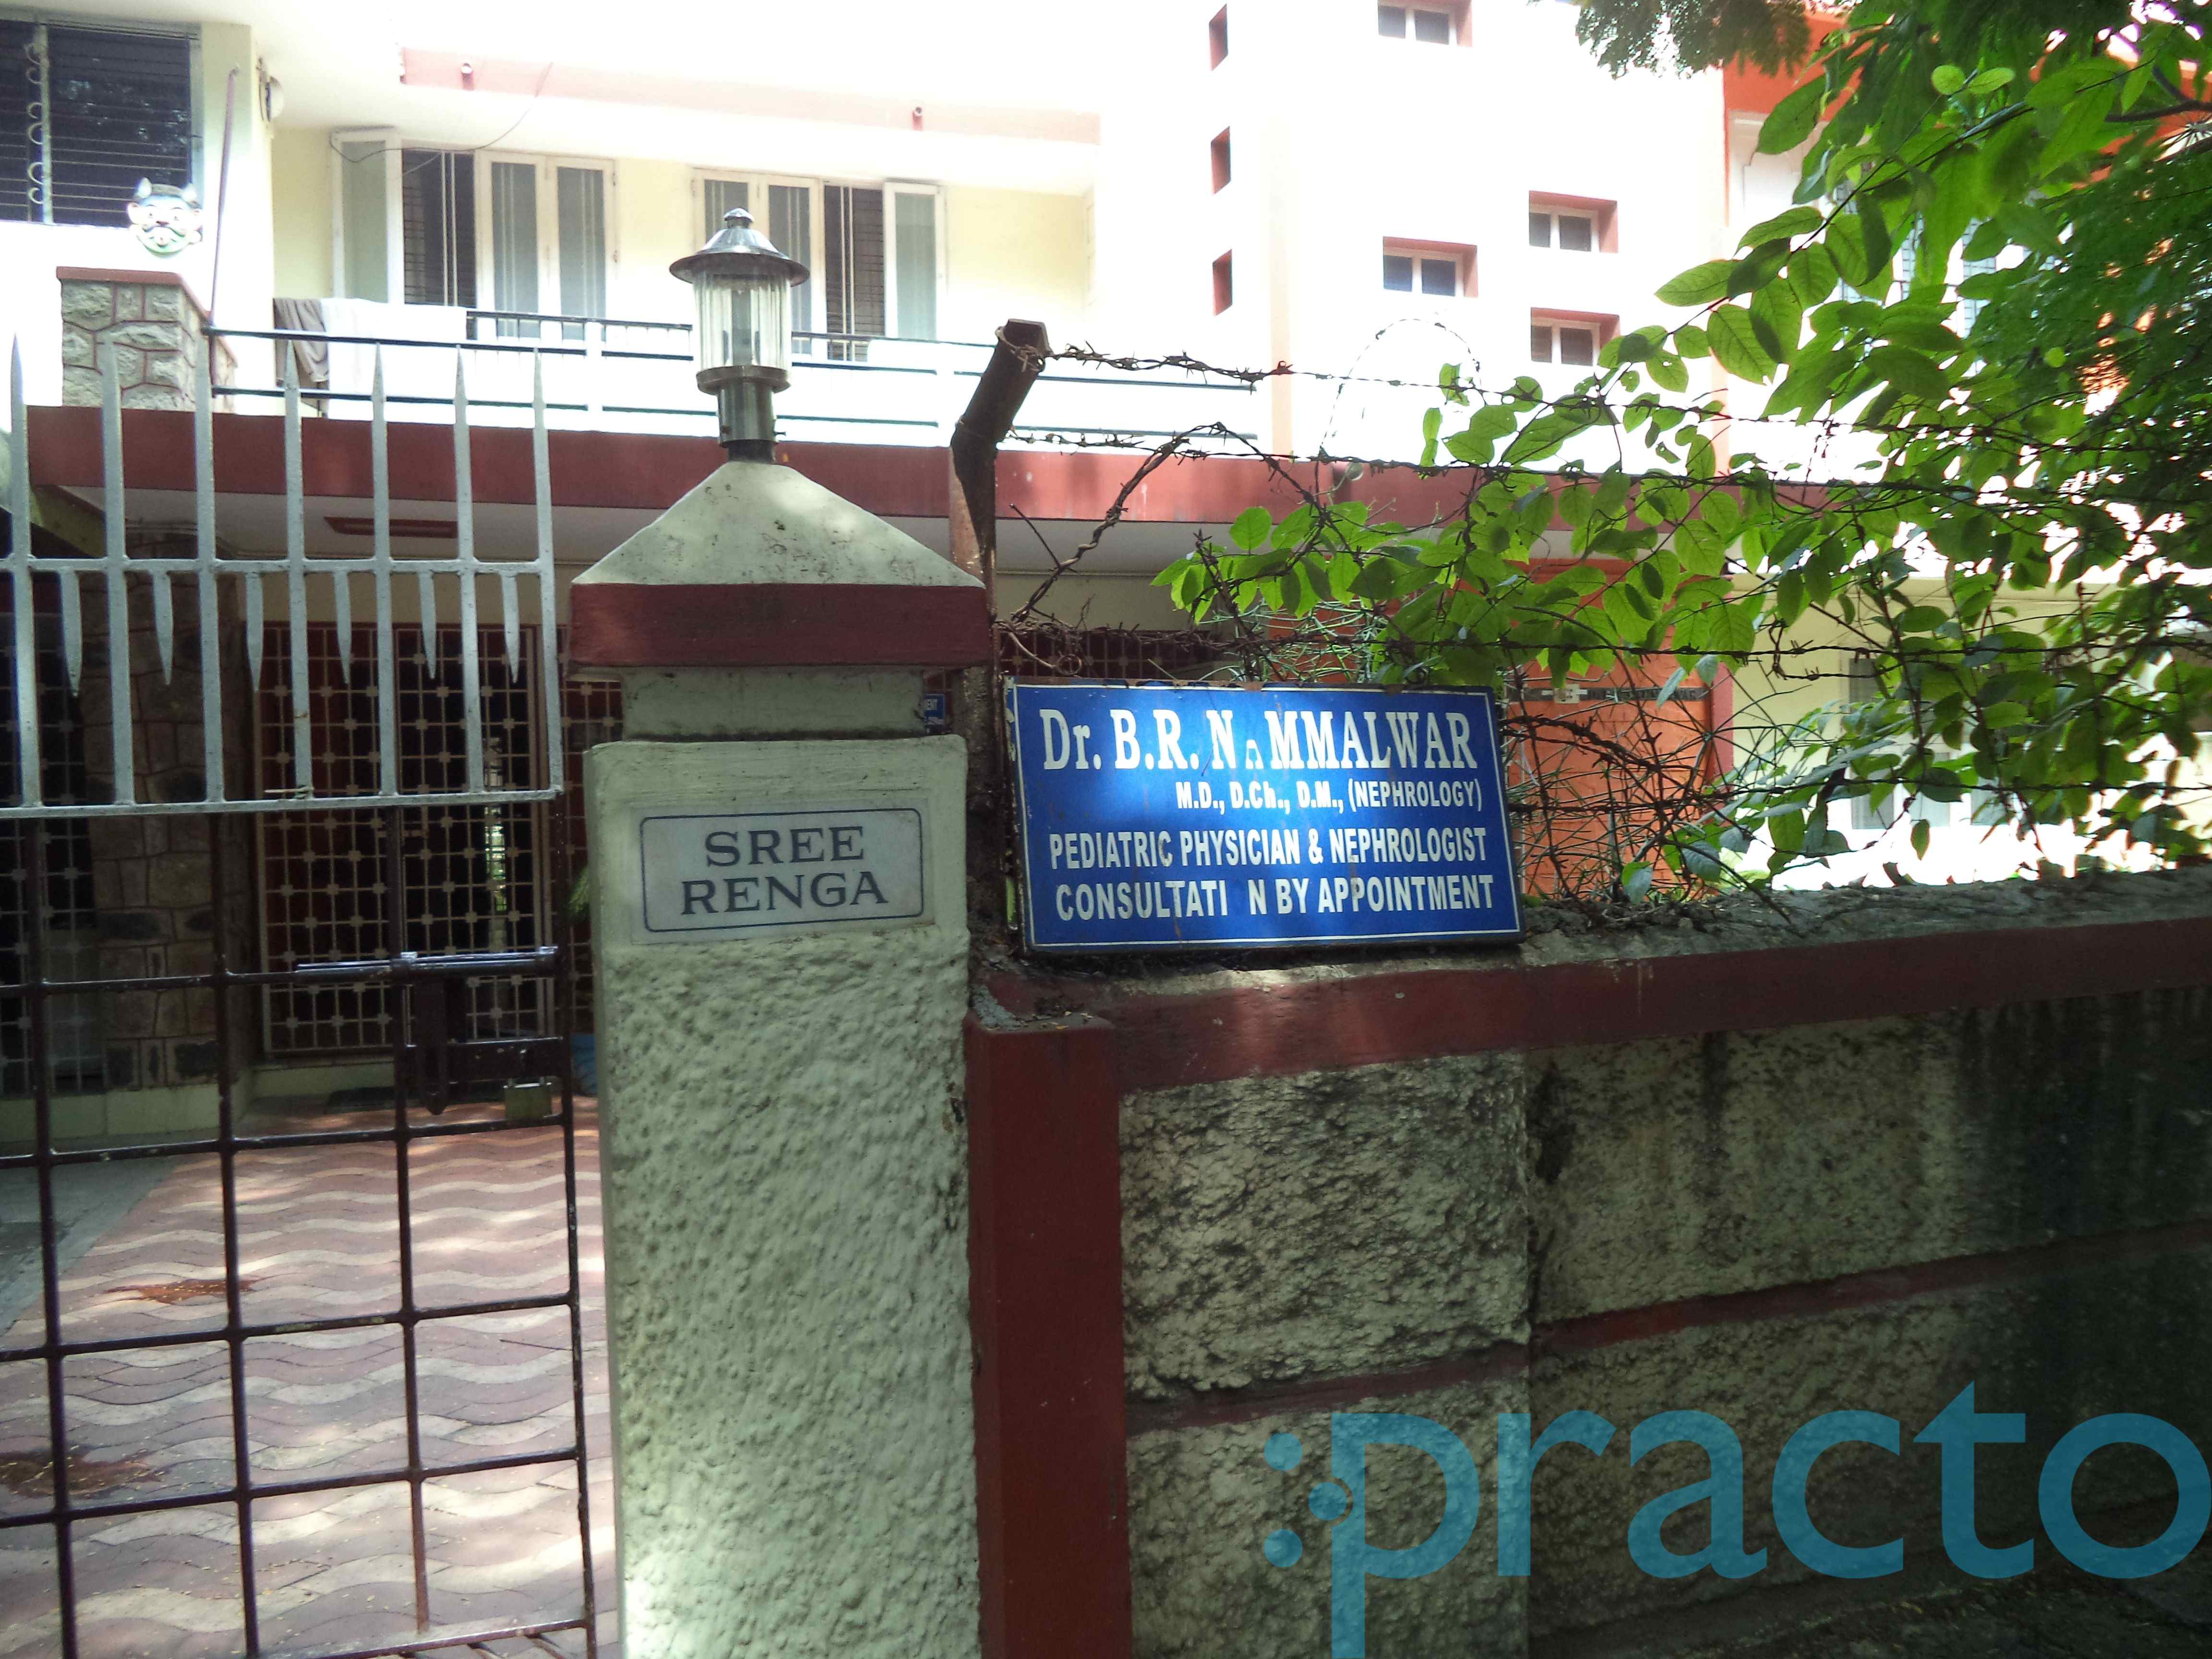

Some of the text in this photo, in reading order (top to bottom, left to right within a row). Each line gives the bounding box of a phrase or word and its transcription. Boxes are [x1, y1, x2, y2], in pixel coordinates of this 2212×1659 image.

[1039, 709, 1102, 770] Dr.
[1109, 709, 1199, 769] B.R.
[1176, 781, 1225, 815] M.D.,
[1296, 781, 1344, 814] D.M.,
[1348, 778, 1482, 812] (NEPHROLOGY)
[704, 826, 865, 867] SREE
[1049, 827, 1487, 869] PEDIATRIC PHYSICIAN & NEPHROLOGIST
[681, 871, 889, 915] RENGA
[1275, 878, 1309, 914] BY
[1318, 874, 1494, 914] APPOINTMENT
